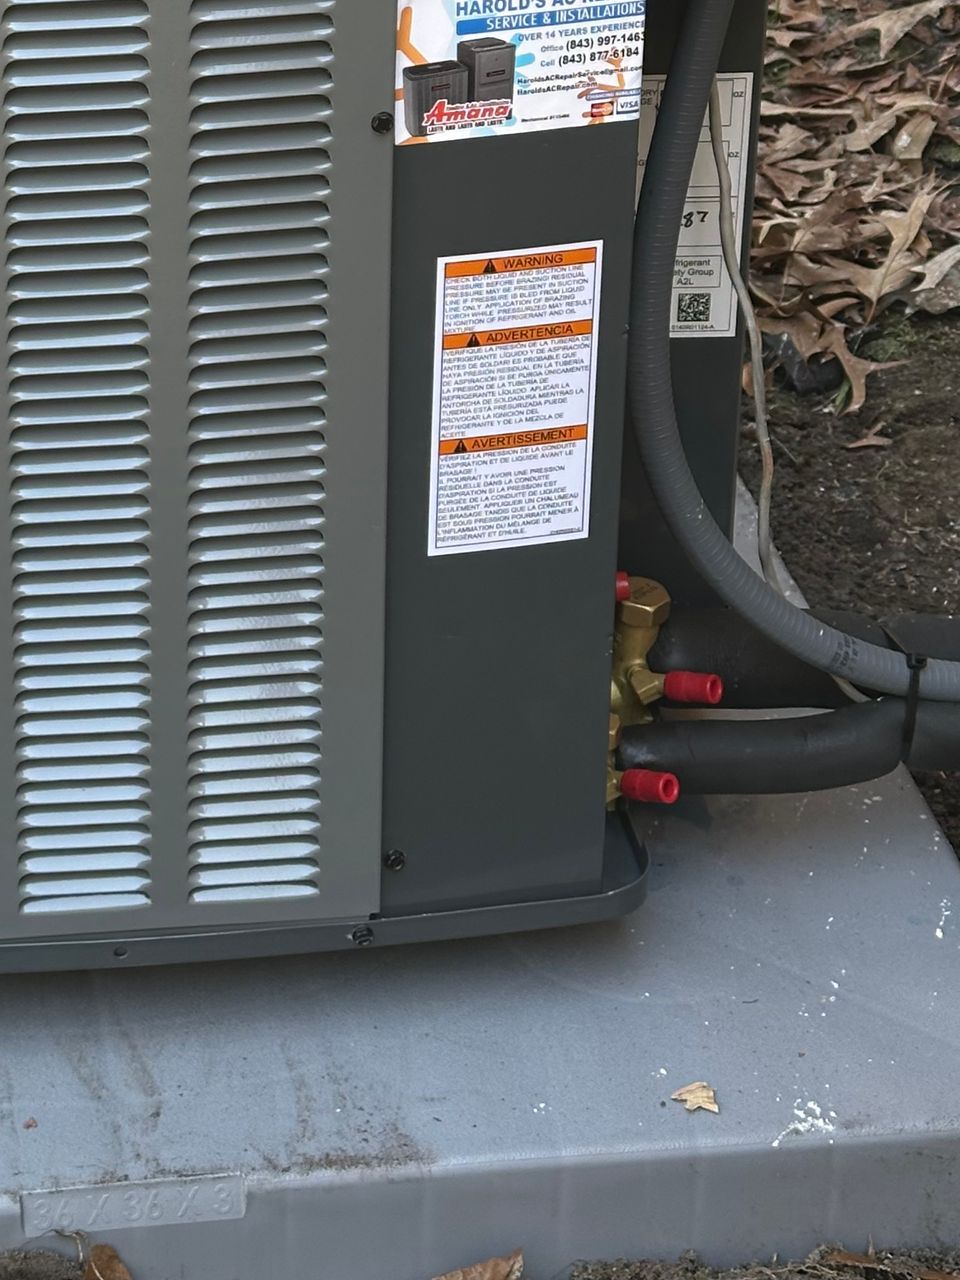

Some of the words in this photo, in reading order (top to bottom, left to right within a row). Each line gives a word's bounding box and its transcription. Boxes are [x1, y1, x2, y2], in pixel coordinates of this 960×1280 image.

[487, 13, 537, 30] SERVICE
[543, 13, 551, 23] &
[556, 1, 644, 22] INSTALLATIONS
[518, 30, 541, 41] OVER
[546, 29, 556, 38] 14
[558, 27, 588, 37] YEARS
[541, 45, 564, 53] Office
[566, 38, 594, 52] (843)
[559, 53, 586, 67] (843)
[590, 47, 639, 61] 877-6184
[517, 81, 597, 95] HaroldsACRepair.com
[426, 100, 509, 123] Amana
[620, 100, 639, 108] VISA
[504, 254, 563, 269] WARNING
[688, 268, 714, 276] Group
[486, 325, 573, 342] ADVERTENCIA
[472, 429, 574, 449] AVERTISSEMENT
